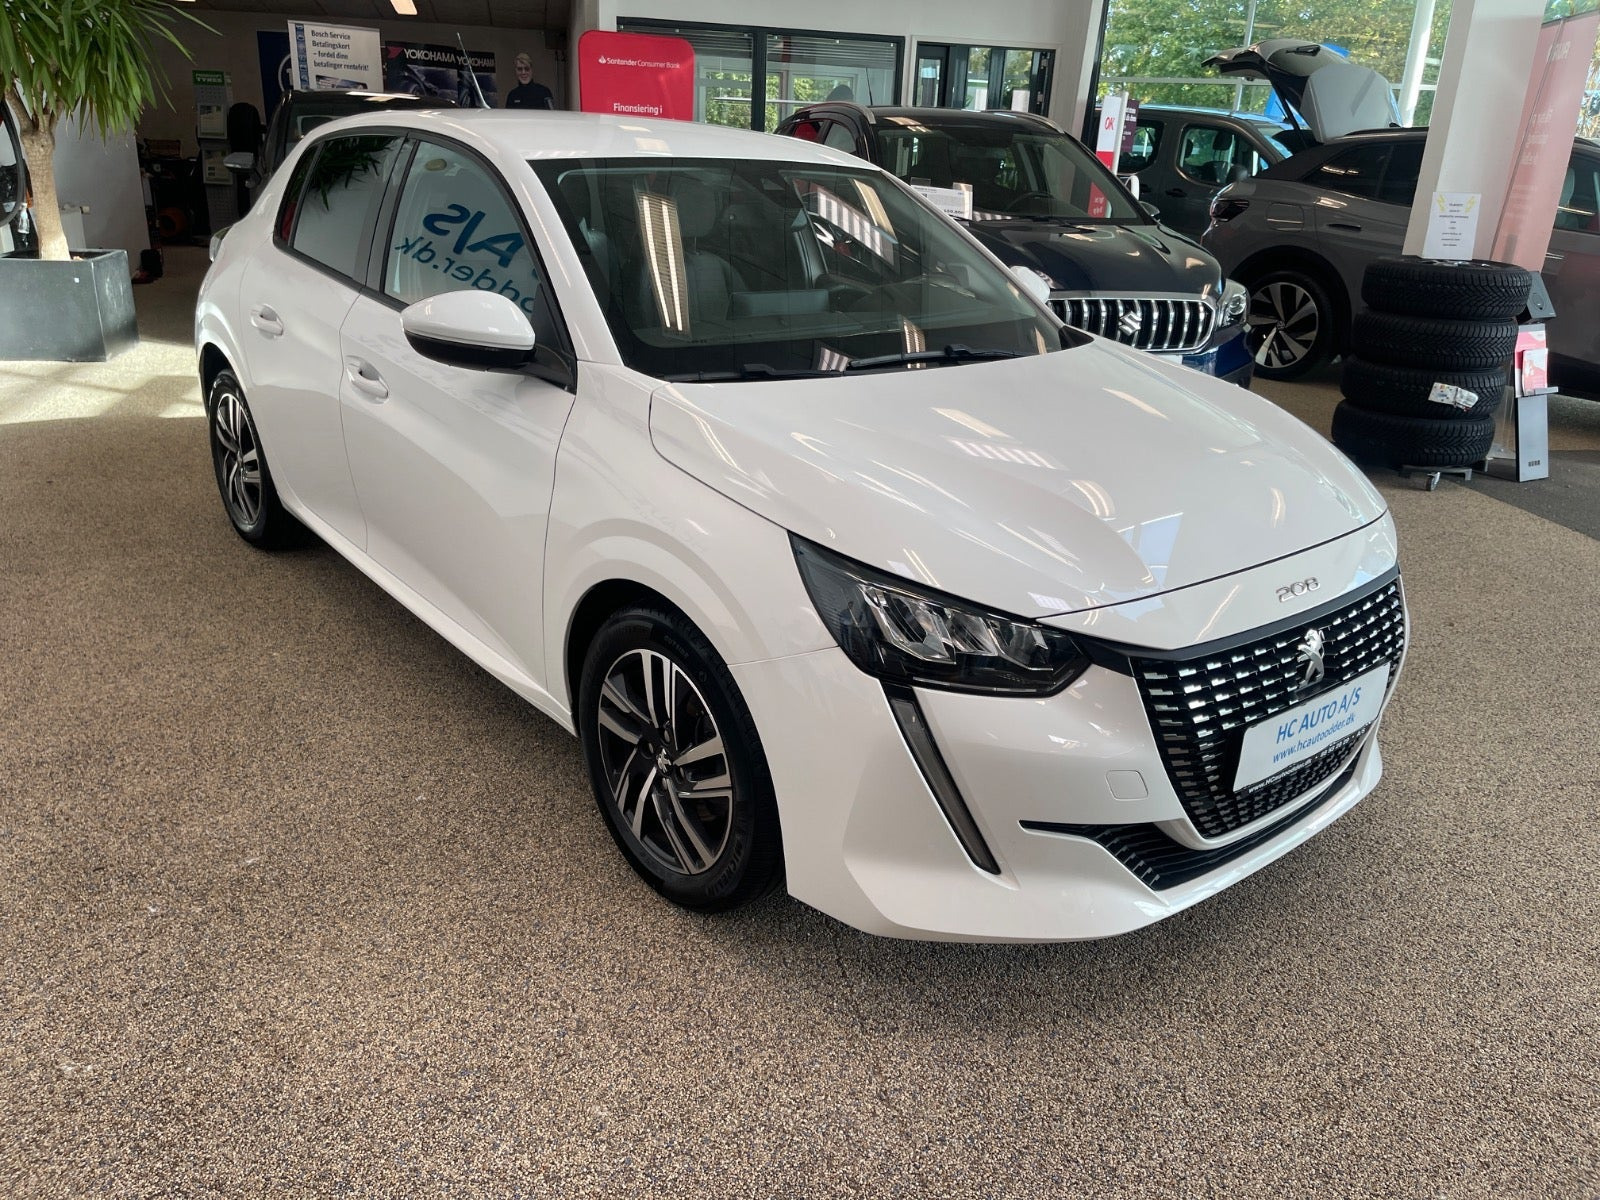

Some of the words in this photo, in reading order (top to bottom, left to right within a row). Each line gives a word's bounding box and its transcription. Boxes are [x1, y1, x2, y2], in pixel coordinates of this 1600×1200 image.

[311, 30, 328, 38] Bosch
[329, 31, 351, 40] Service
[404, 48, 456, 64] YOKOHAMA
[607, 57, 637, 66] Santander
[637, 59, 666, 69] Consumer
[666, 61, 680, 69] Bank
[613, 102, 659, 116] Finansiering
[1104, 116, 1116, 132] OK
[1276, 576, 1321, 603] 208
[1276, 718, 1298, 745] HC
[1298, 700, 1338, 735] AUTO
[1338, 687, 1362, 714] A/S
[1272, 712, 1356, 764] www.hcautoodder.dk
